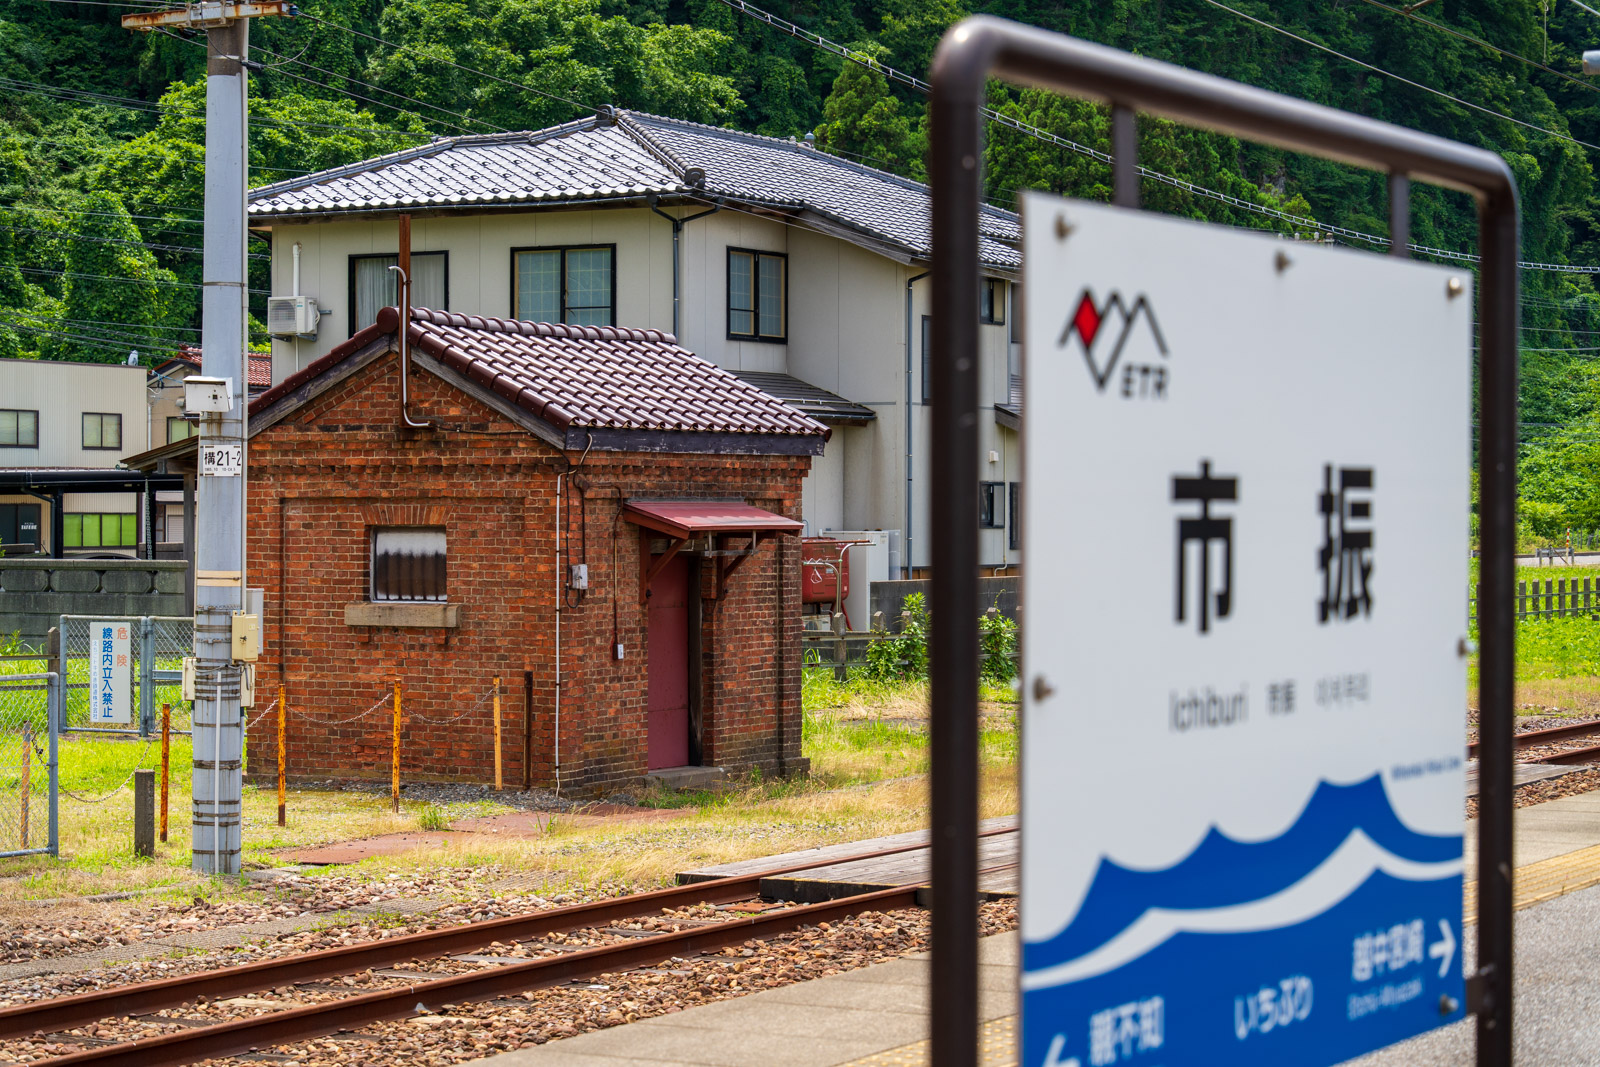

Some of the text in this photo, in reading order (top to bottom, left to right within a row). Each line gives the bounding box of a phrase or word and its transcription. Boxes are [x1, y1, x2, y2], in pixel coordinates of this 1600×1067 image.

[1122, 363, 1169, 399] ETR
[204, 450, 241, 467] 構21-2
[1170, 457, 1374, 635] 市振
[116, 626, 128, 668] 危険
[102, 626, 113, 718] 線路内立入禁止
[1168, 685, 1249, 733] Ichiburi
